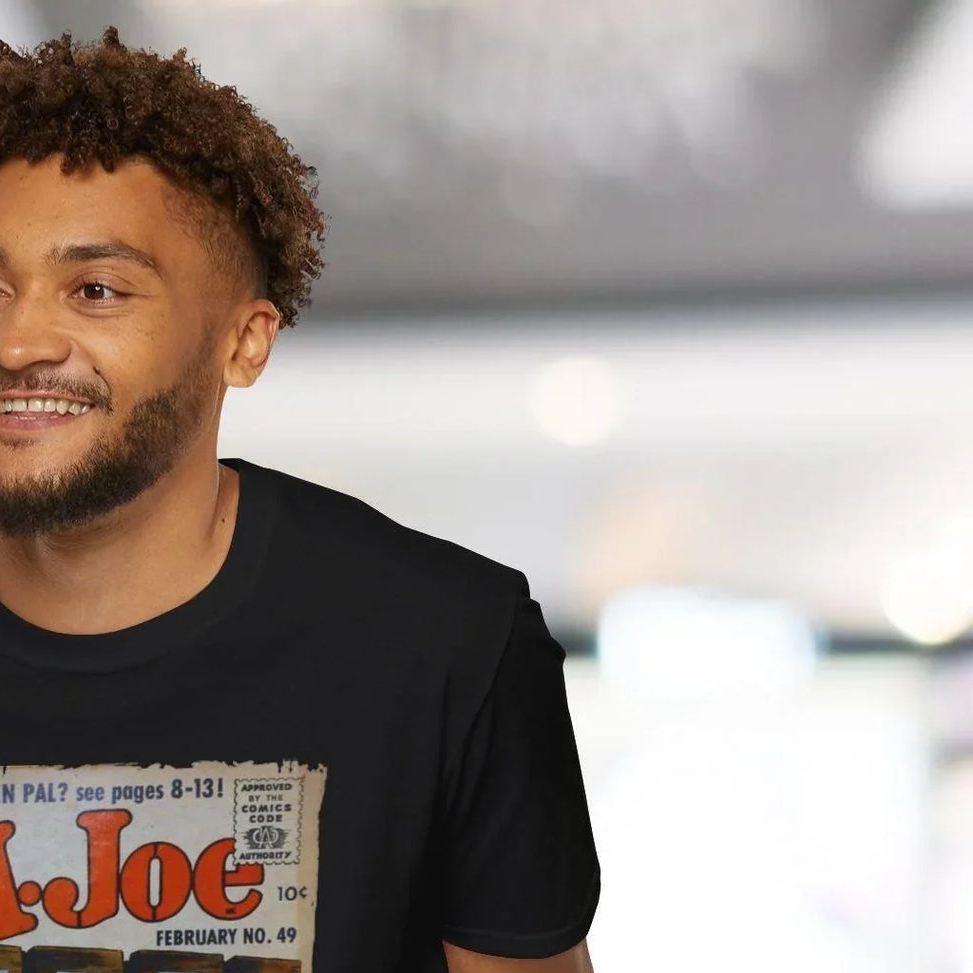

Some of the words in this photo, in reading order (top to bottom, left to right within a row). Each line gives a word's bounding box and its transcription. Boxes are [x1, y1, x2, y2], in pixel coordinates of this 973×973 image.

[23, 783, 68, 803] PAL?
[77, 784, 104, 802] see
[112, 780, 163, 803] pages
[171, 777, 223, 799] 8-13!
[241, 783, 292, 792] APPROVED
[241, 804, 292, 813] COMICS
[249, 814, 283, 823] CODE
[239, 851, 292, 860] AUTHORITY
[277, 885, 308, 902] 10¢
[156, 928, 237, 946] FEBRUARY
[243, 928, 272, 944] NO.
[276, 927, 297, 943] 49
